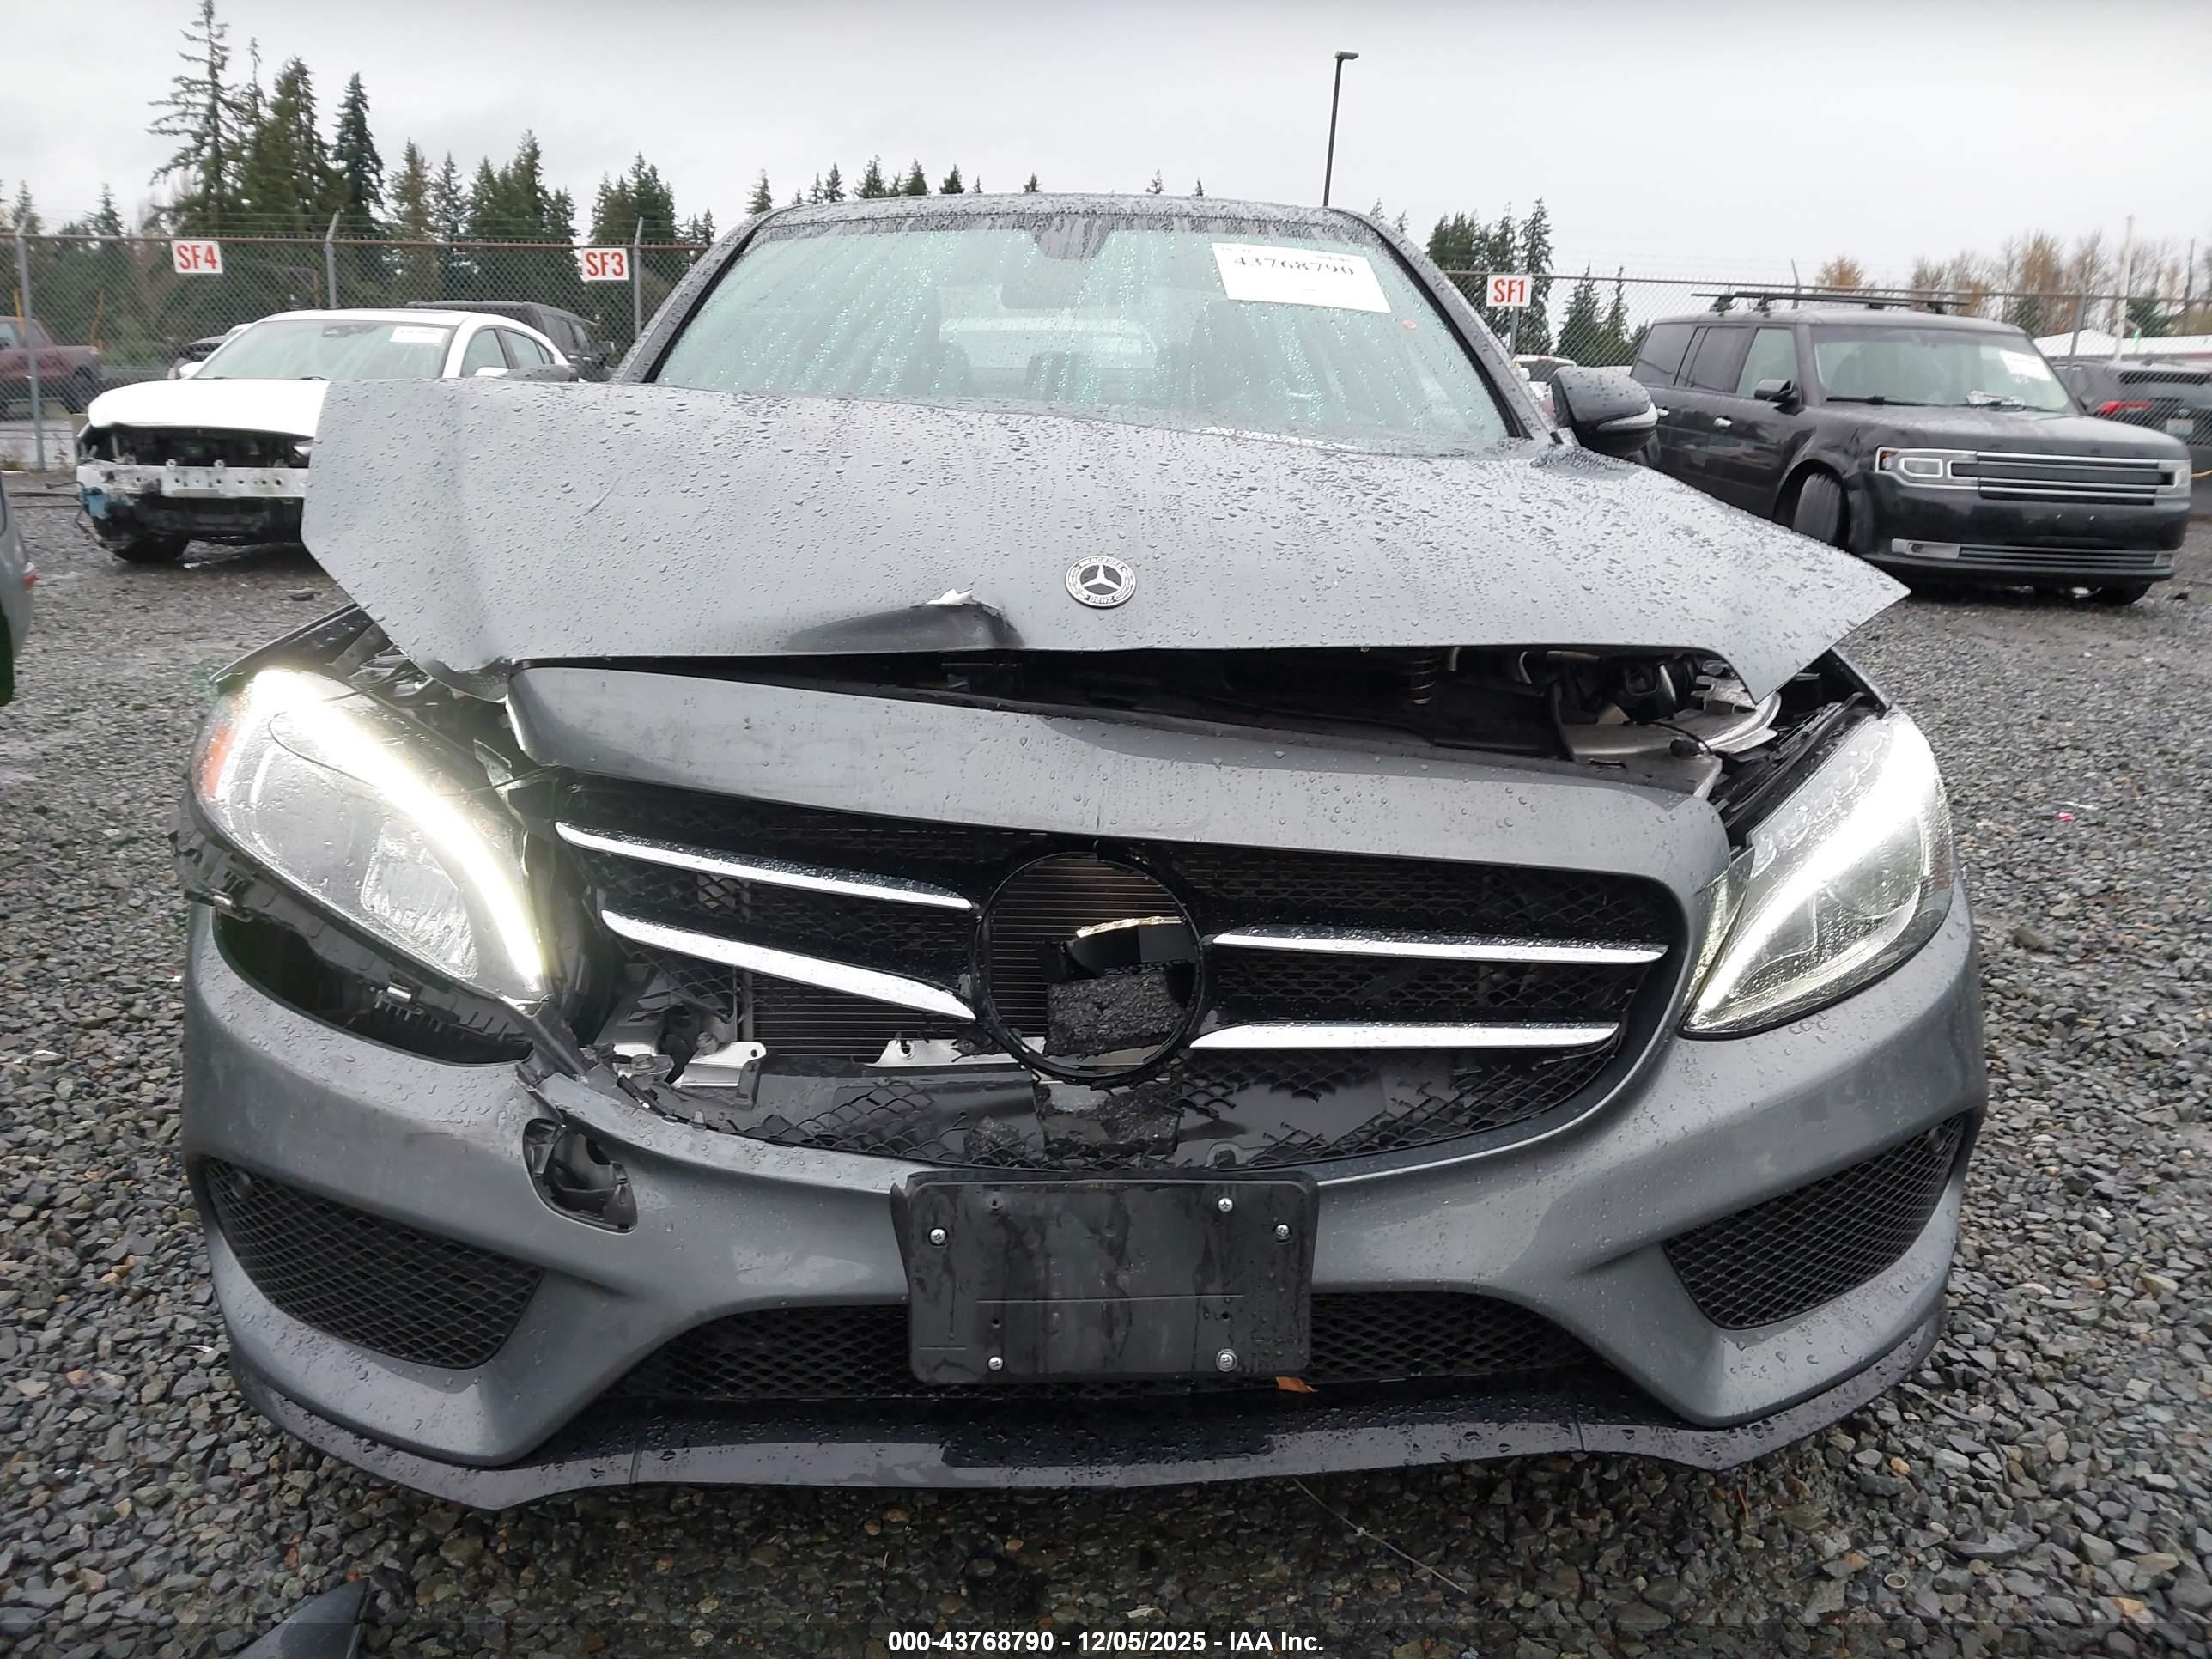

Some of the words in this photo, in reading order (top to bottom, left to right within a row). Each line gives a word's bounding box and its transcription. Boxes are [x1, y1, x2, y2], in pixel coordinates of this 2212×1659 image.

[177, 244, 217, 269] SF4
[585, 252, 624, 276] SF3
[1234, 256, 1355, 276] 43768790
[1494, 279, 1525, 302] SF1
